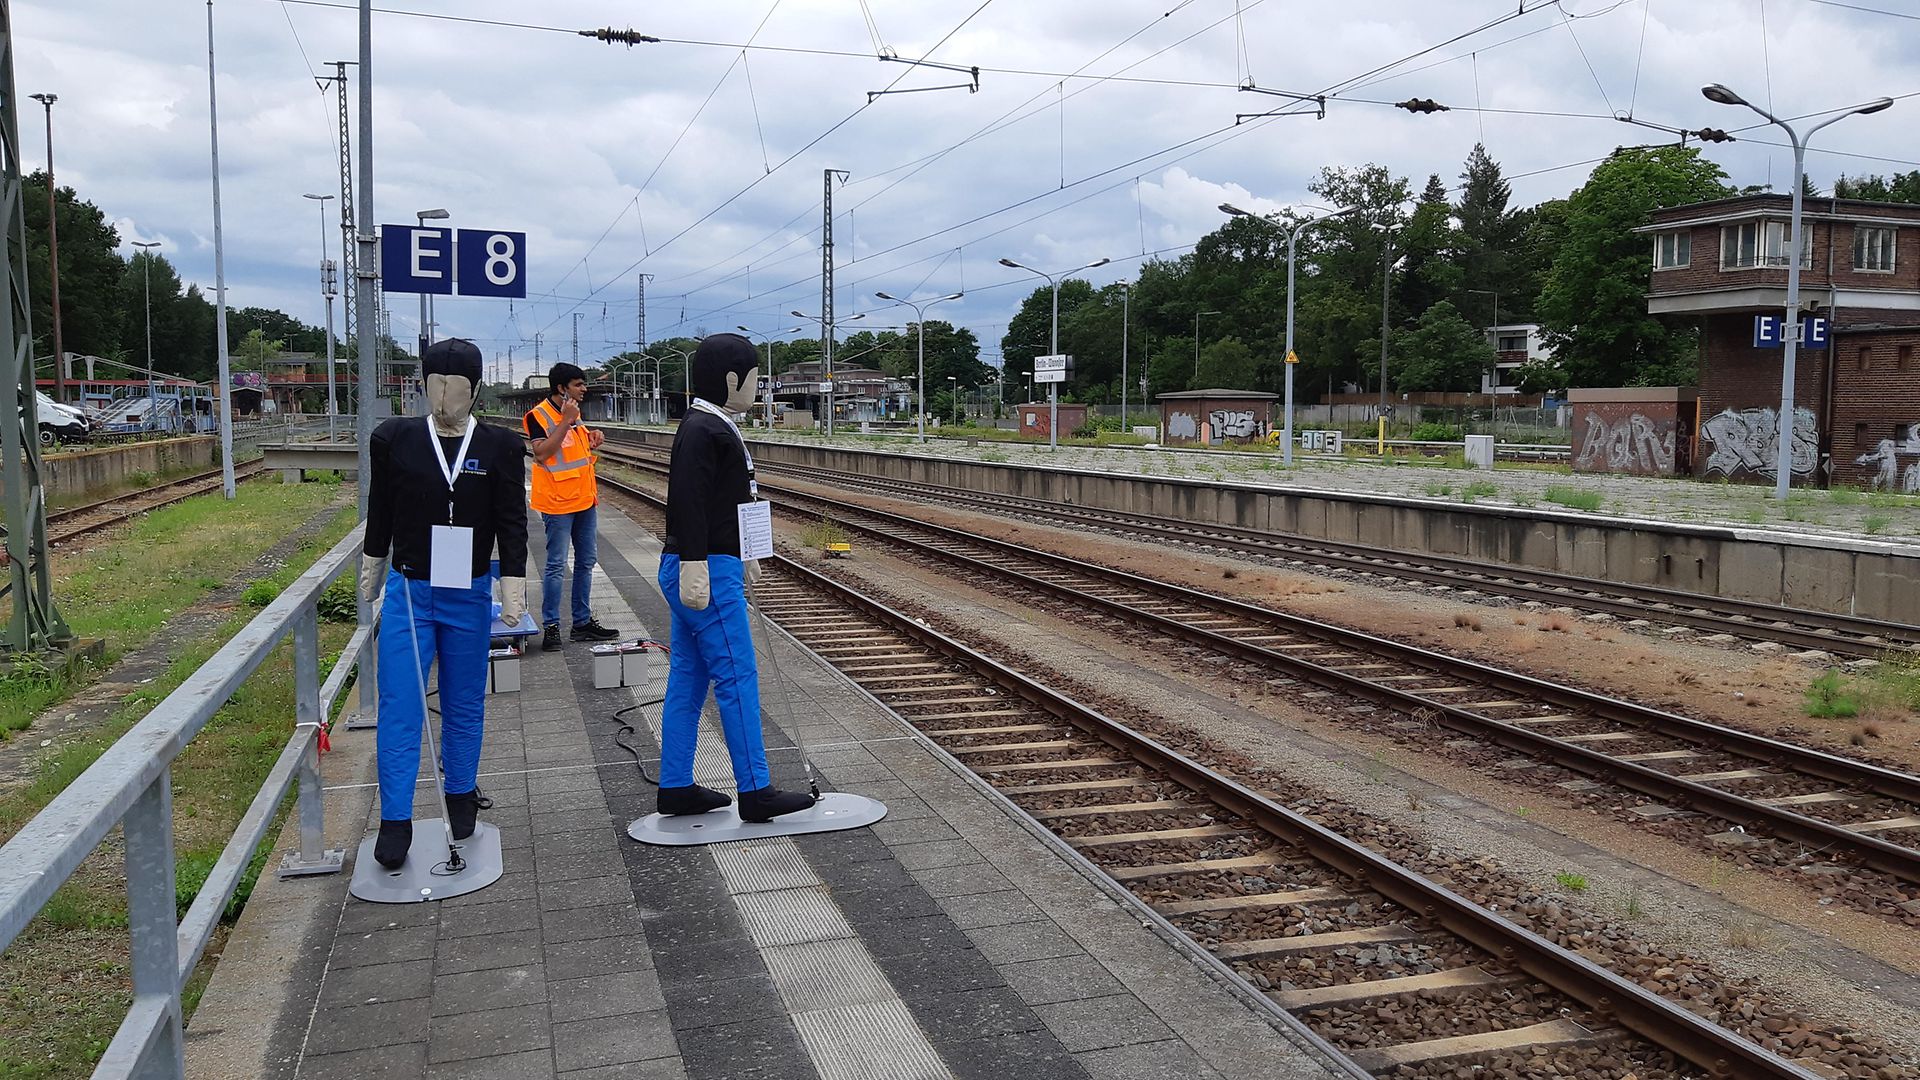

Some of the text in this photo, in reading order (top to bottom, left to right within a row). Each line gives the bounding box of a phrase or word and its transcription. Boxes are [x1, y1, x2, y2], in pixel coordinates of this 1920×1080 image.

[411, 229, 517, 286] E 8
[1760, 316, 1773, 340] E
[1813, 318, 1825, 342] E
